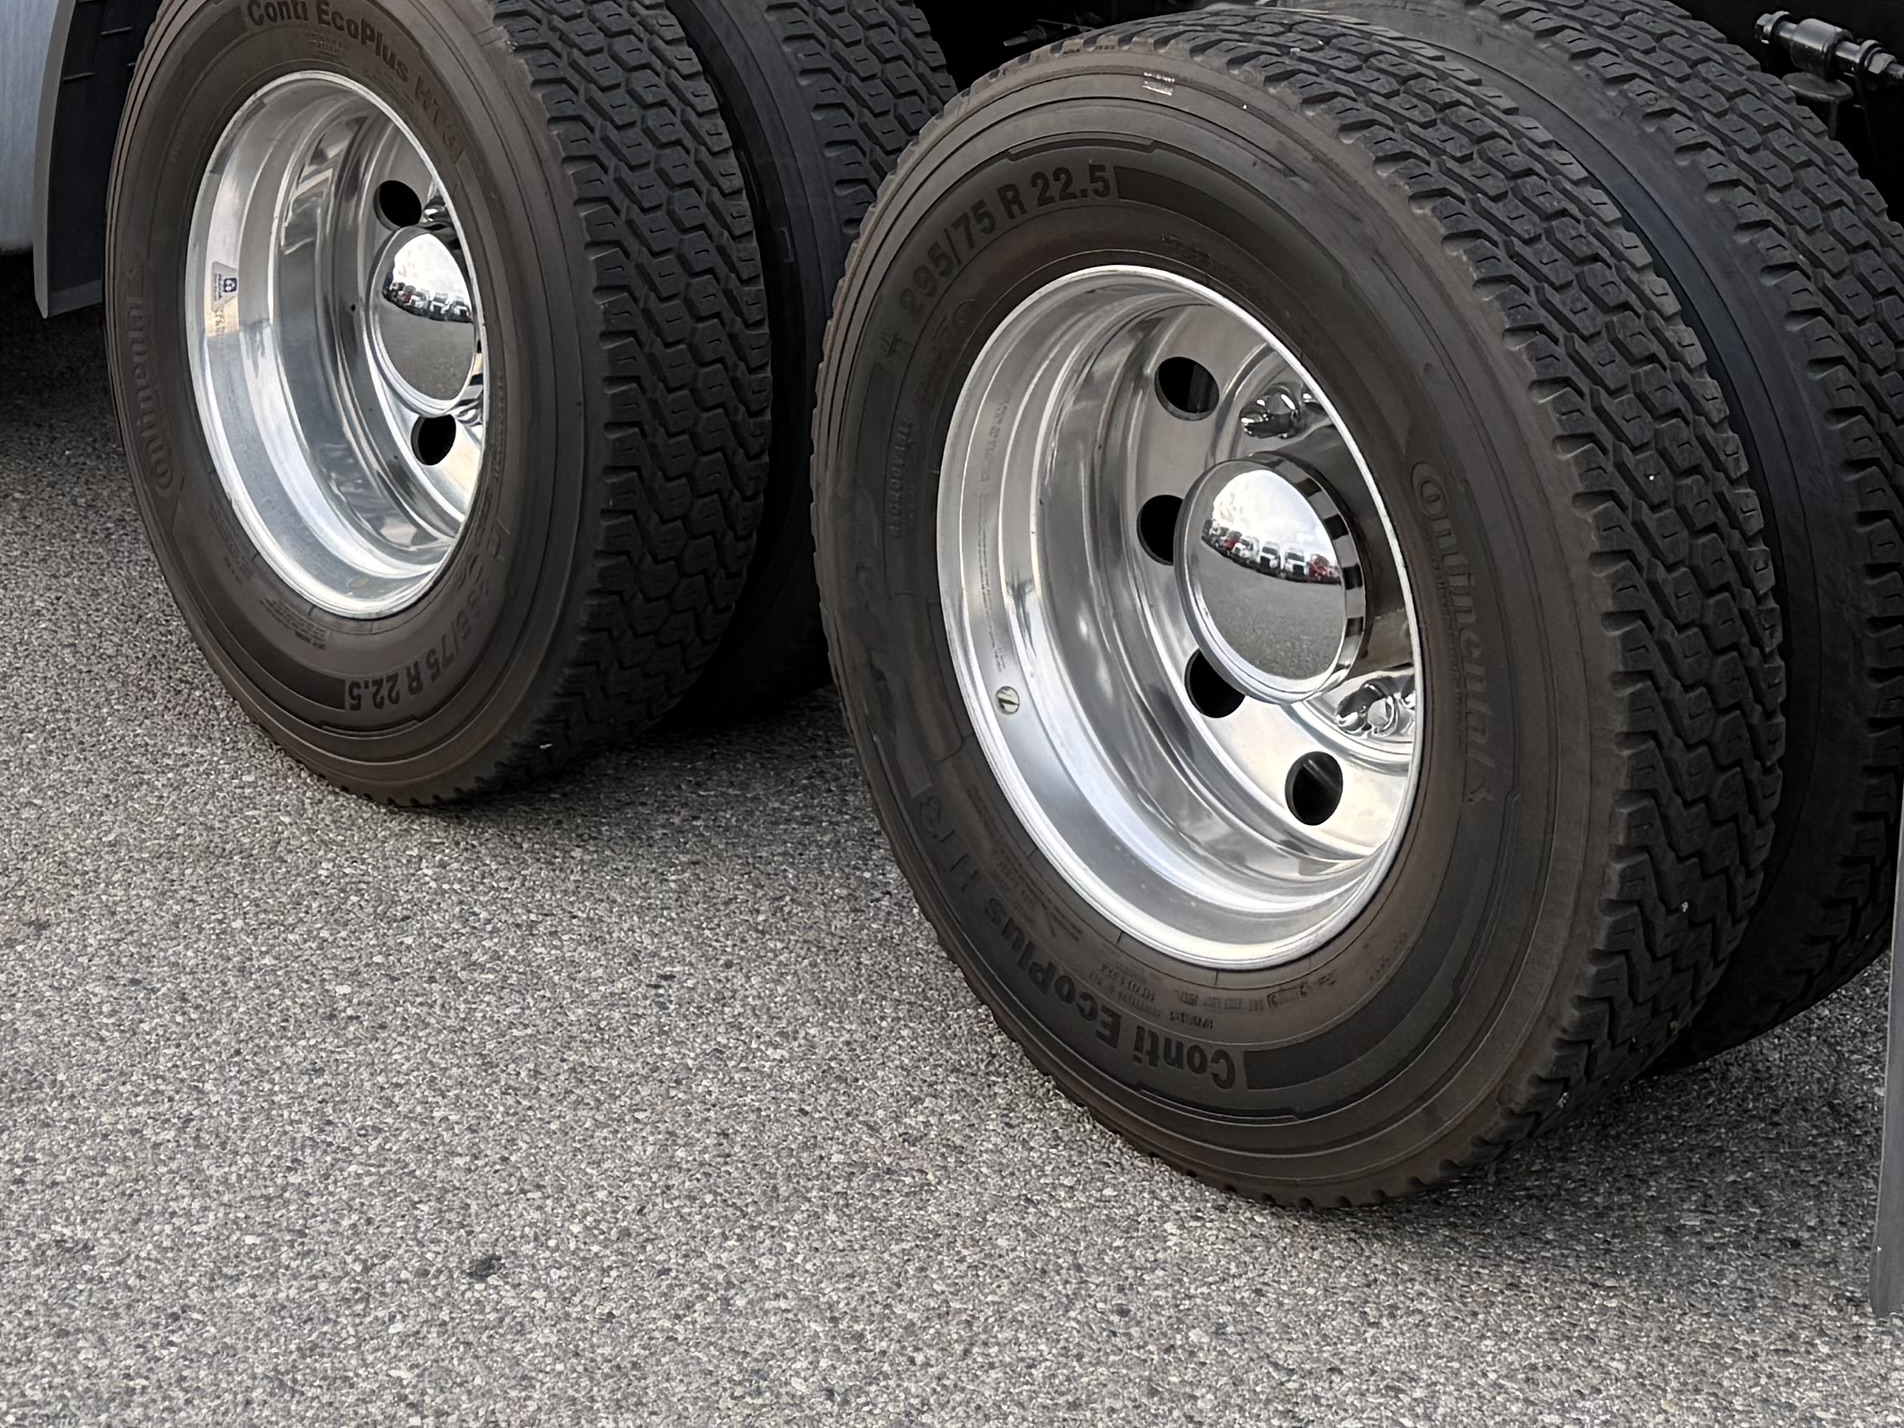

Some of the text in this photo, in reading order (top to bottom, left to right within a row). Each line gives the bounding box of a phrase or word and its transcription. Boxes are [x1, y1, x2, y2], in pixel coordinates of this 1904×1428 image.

[899, 162, 1112, 319] 295/75 R 22.5
[1410, 461, 1496, 770] Continental
[347, 672, 400, 711] 22.5
[405, 661, 424, 695] R
[983, 897, 1122, 1049] EcoPlus
[1132, 1024, 1237, 1091] Conti
